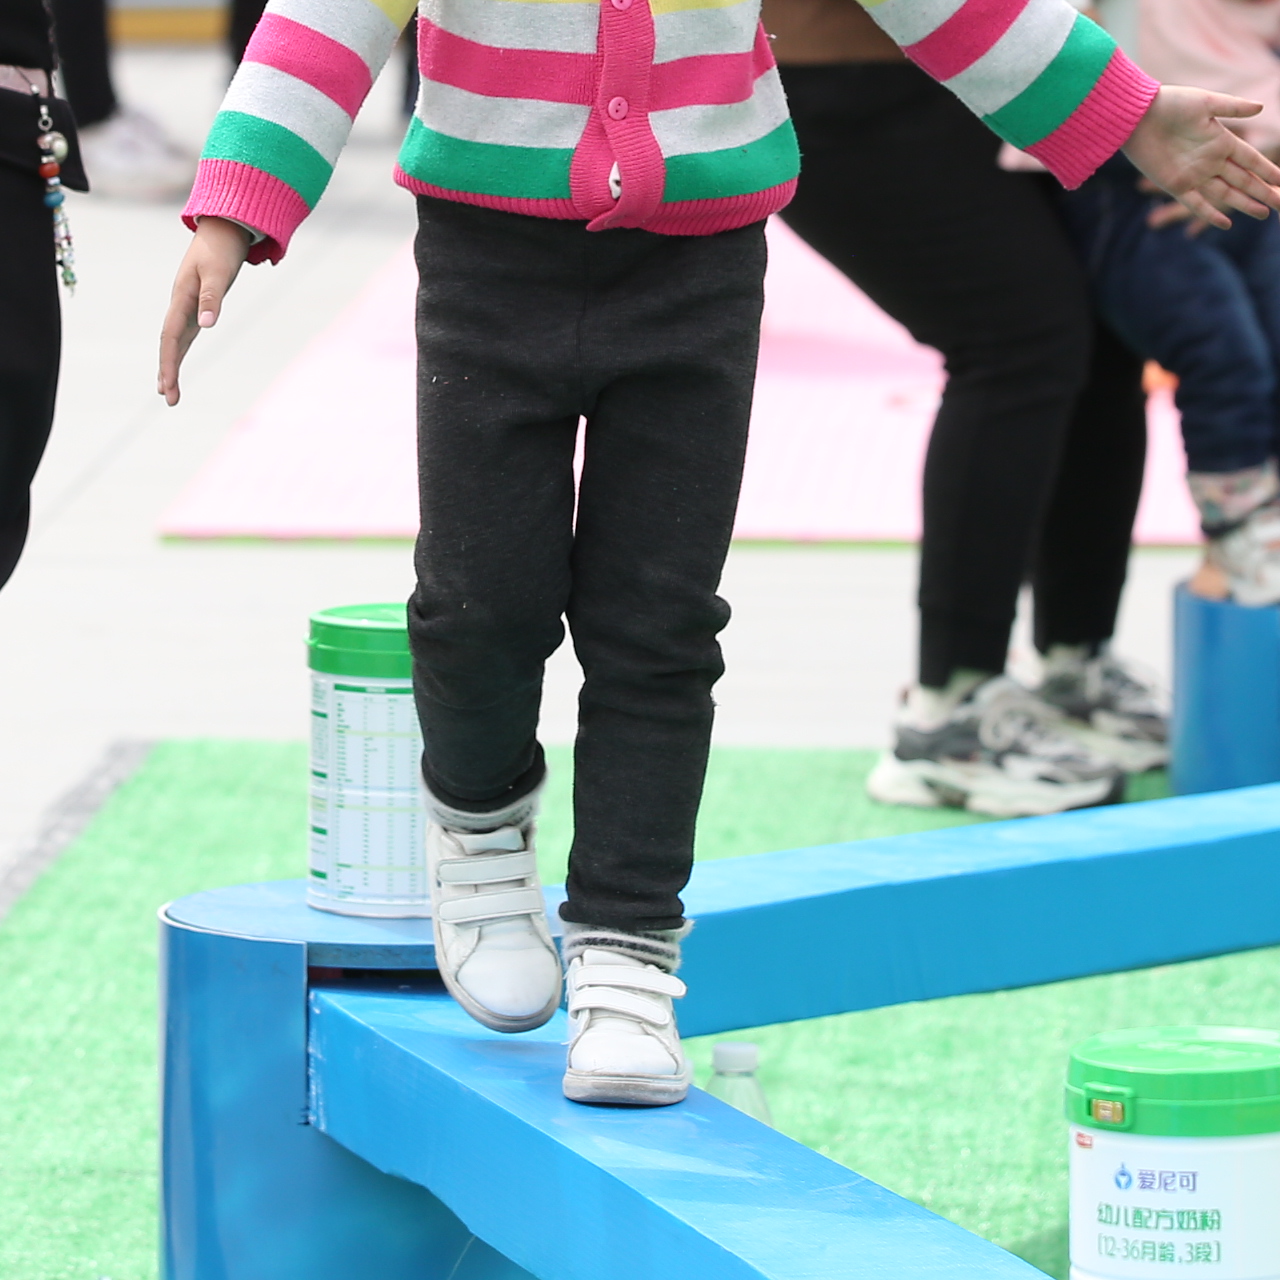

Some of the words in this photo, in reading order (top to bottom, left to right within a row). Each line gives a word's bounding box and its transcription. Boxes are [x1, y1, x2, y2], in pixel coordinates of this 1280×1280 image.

[1137, 1168, 1198, 1192] 爱尼可
[1097, 1202, 1221, 1231] 幼儿配方奶粉
